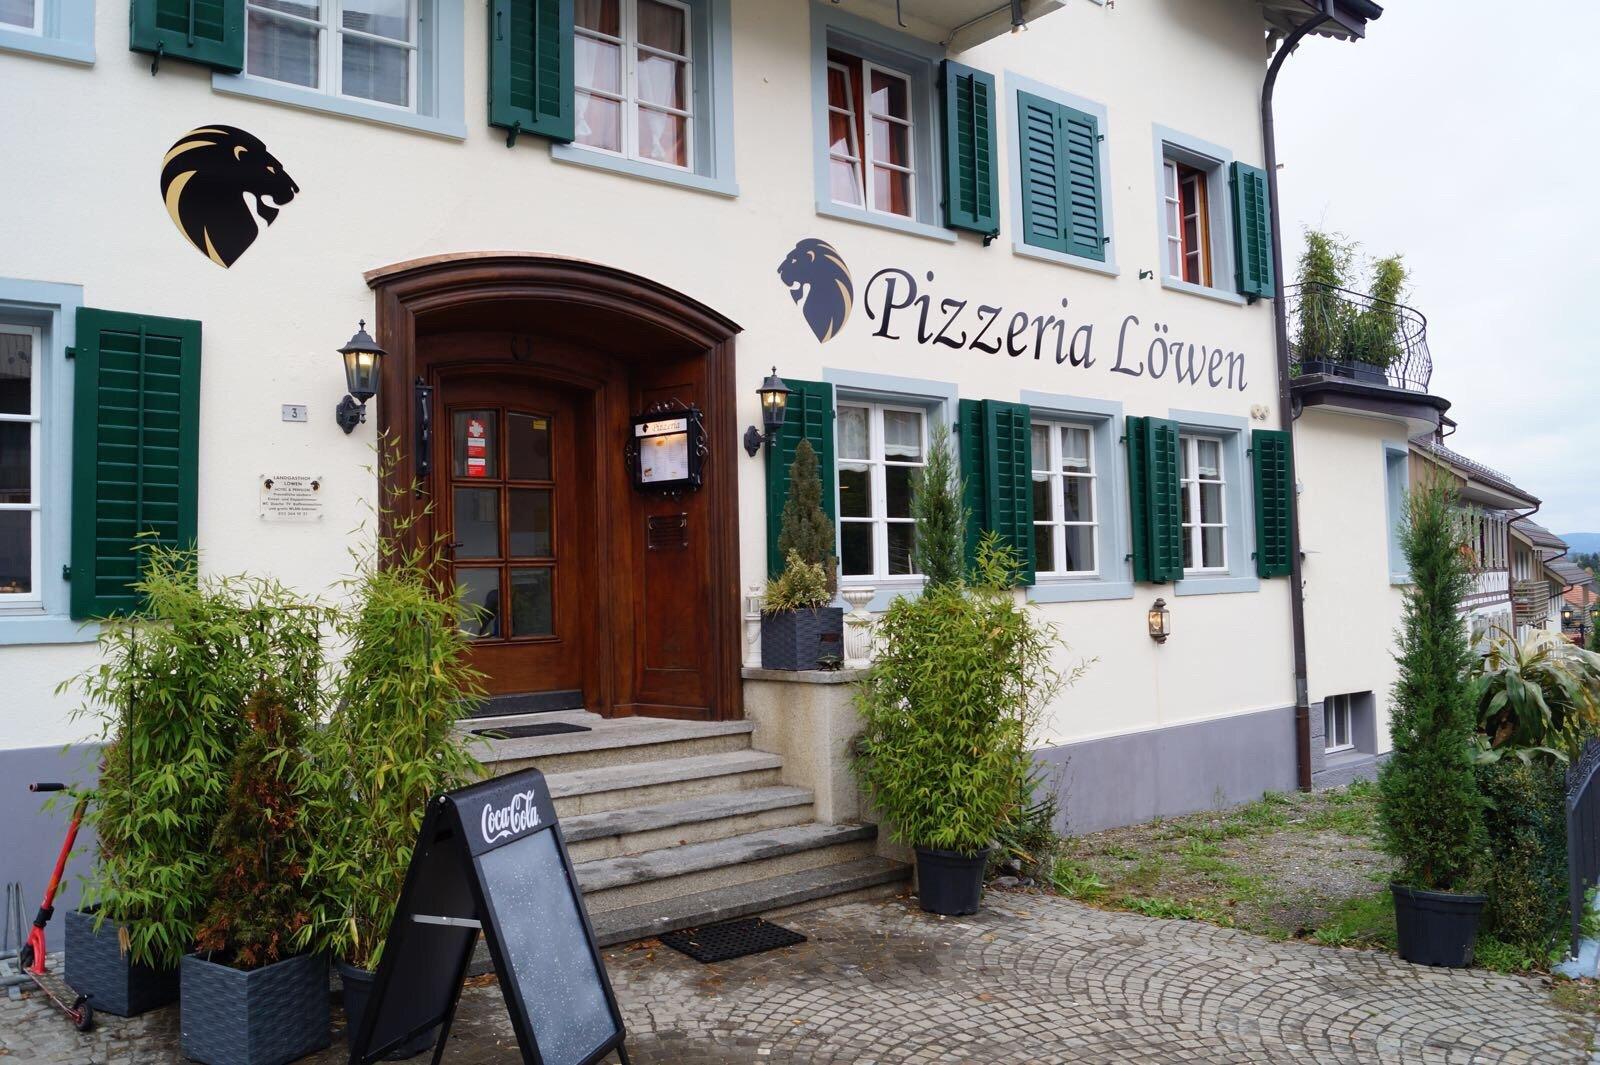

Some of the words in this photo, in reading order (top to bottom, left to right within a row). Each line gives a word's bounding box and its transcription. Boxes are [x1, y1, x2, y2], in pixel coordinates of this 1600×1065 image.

[864, 267, 1096, 368] Pizzeria
[1110, 315, 1249, 392] Löwen
[291, 408, 298, 418] 3
[481, 789, 539, 844] Coca-Cola
